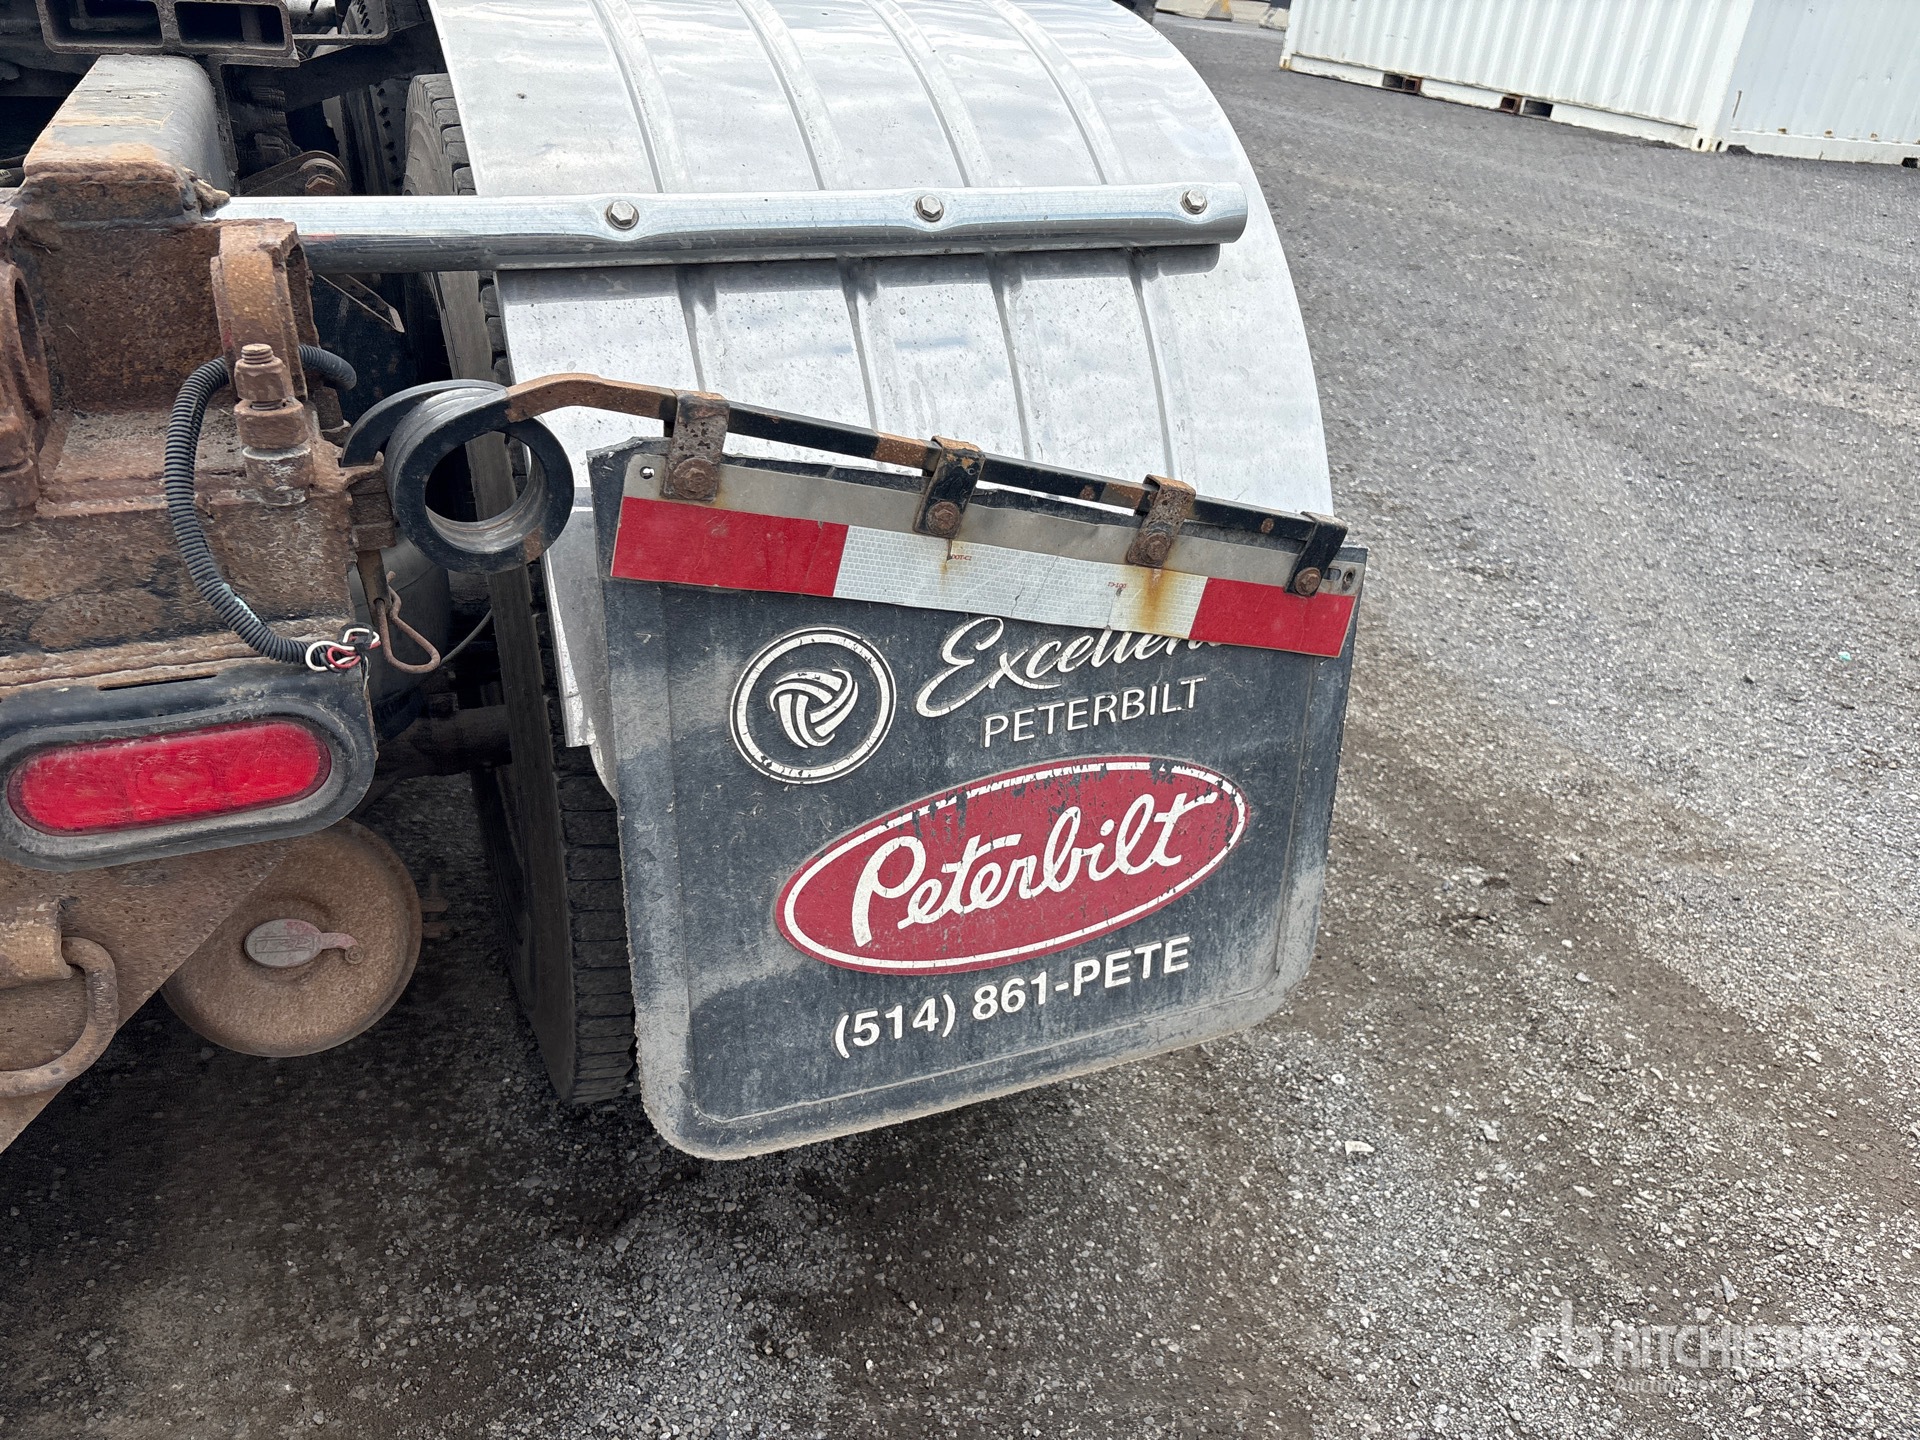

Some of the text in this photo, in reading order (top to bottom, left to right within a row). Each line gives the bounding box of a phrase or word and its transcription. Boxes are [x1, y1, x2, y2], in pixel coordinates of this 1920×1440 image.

[983, 676, 1207, 748] PETERBILT
[851, 792, 1219, 948] Peterbilt
[833, 935, 1191, 1059] (514) 861-PETE
